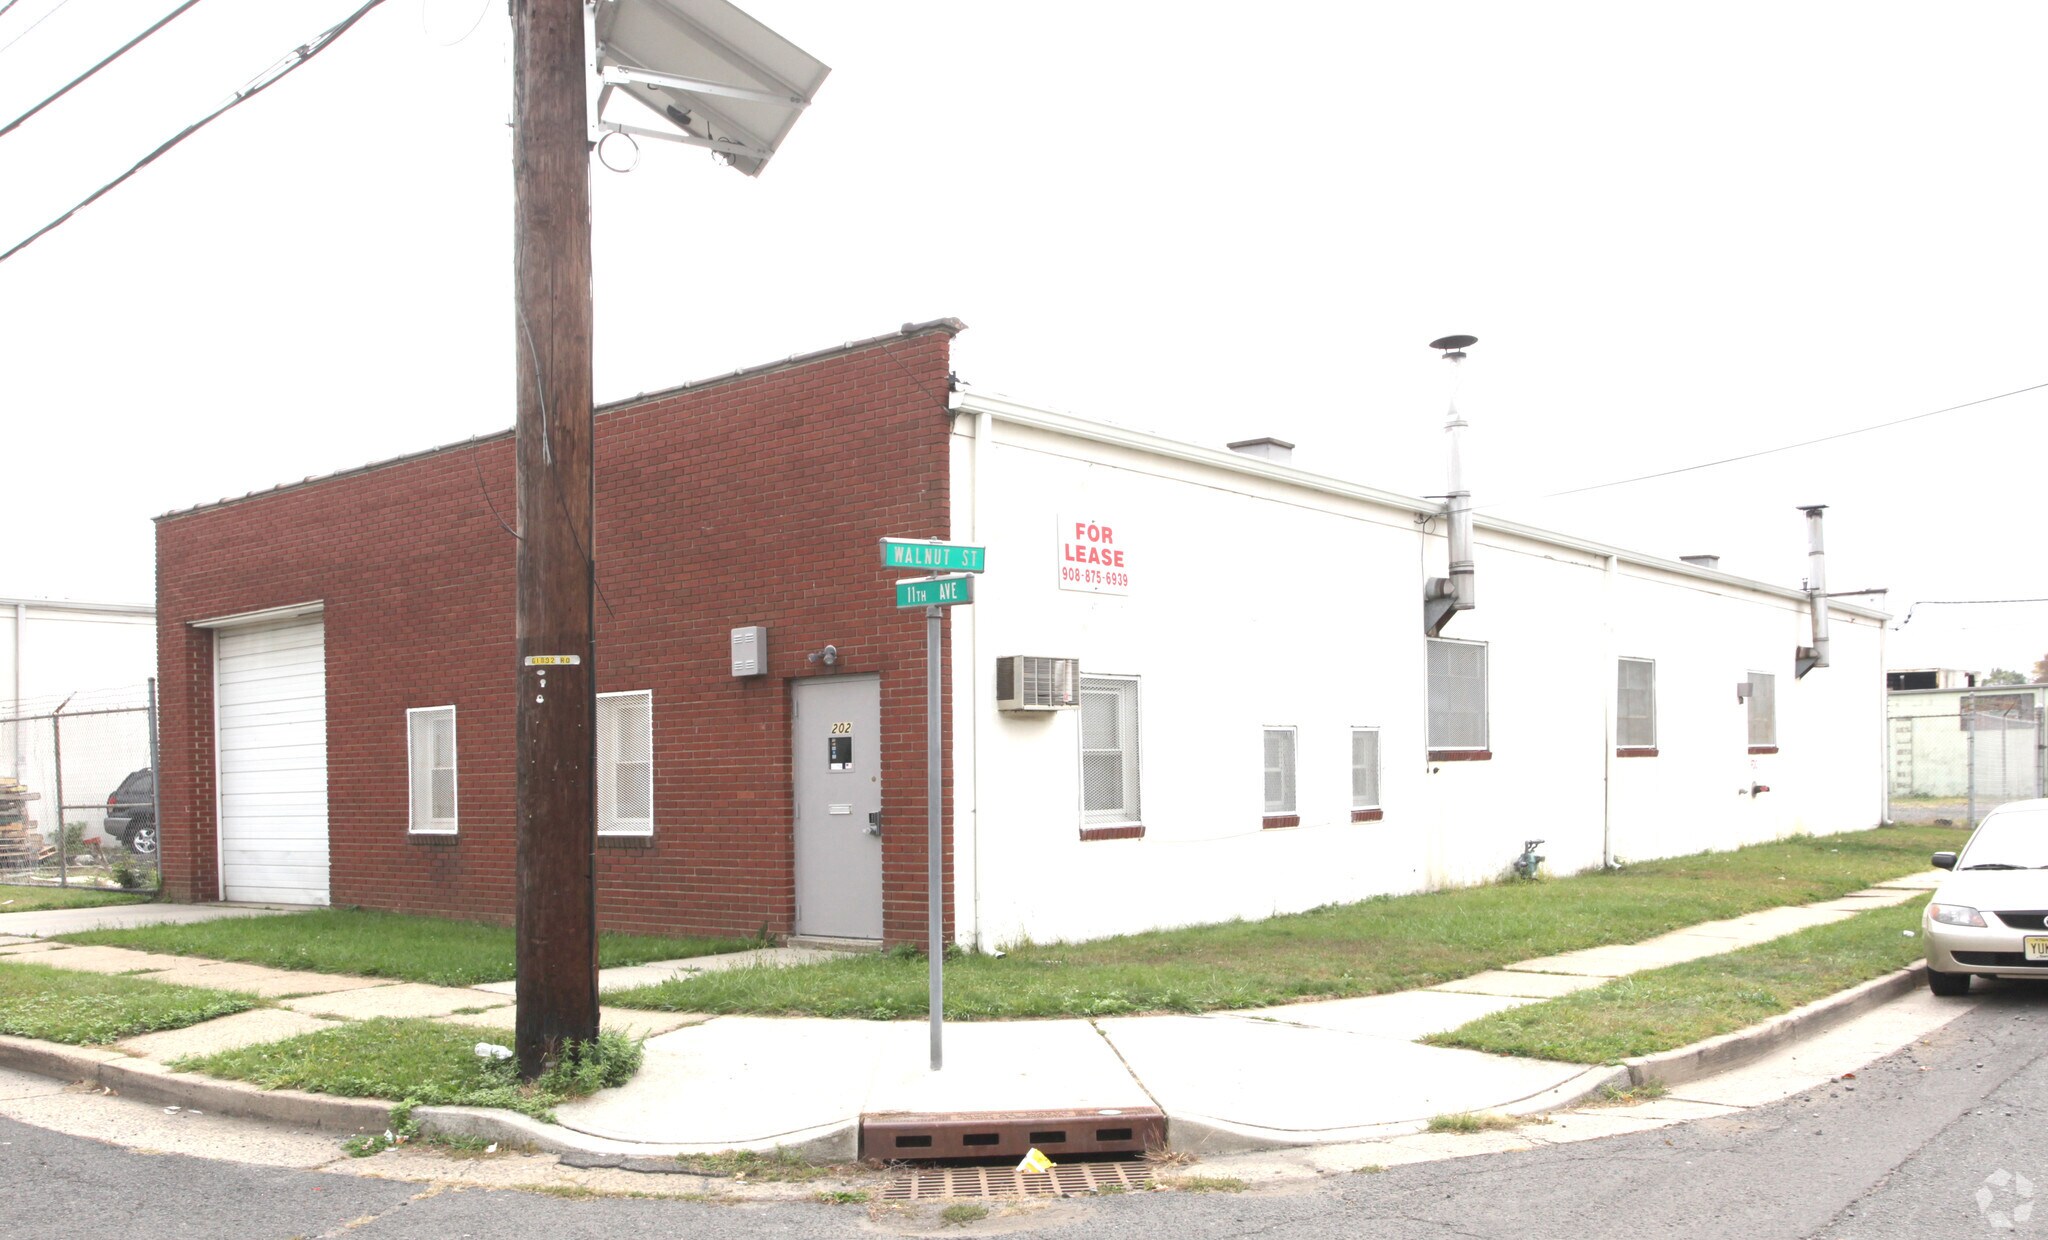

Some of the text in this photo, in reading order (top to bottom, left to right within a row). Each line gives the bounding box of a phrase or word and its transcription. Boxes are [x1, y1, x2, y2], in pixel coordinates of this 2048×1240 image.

[1075, 522, 1113, 544] FOR
[894, 546, 977, 566] WALNUT ST
[1064, 543, 1125, 568] LEASE
[1062, 566, 1128, 587] 908-875-6939
[907, 582, 957, 603] 11TH AVE
[831, 722, 852, 734] 202
